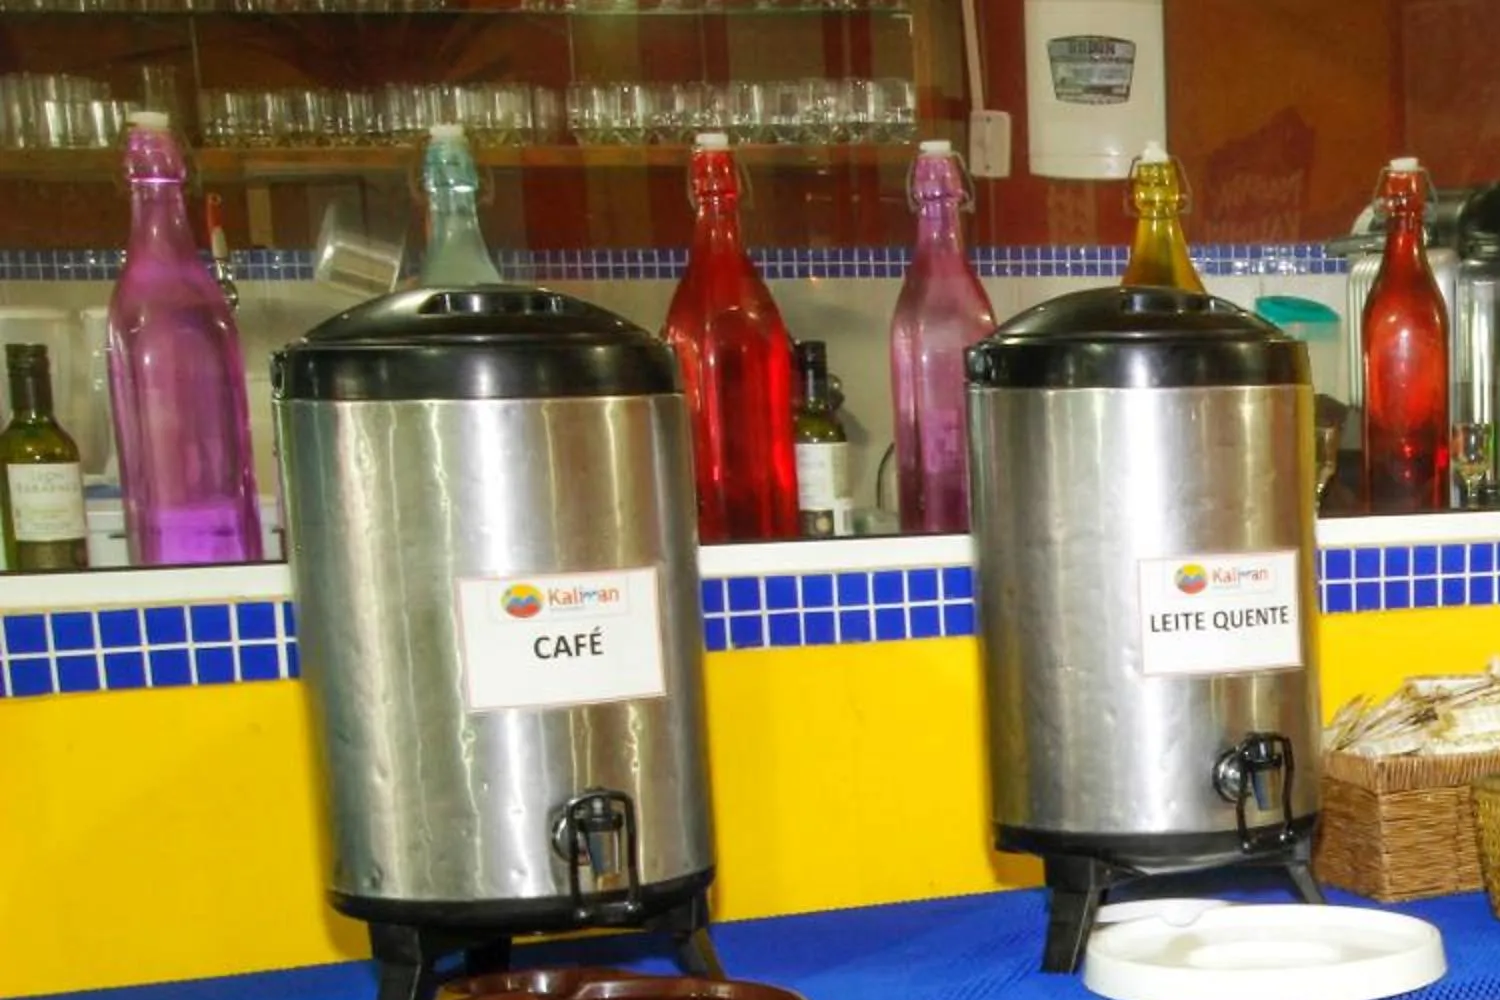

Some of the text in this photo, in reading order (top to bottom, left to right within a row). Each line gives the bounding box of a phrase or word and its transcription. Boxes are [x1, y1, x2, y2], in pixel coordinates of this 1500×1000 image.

[1150, 605, 1290, 633] LEITE QUENTE
[533, 626, 604, 660] CAFÉ
